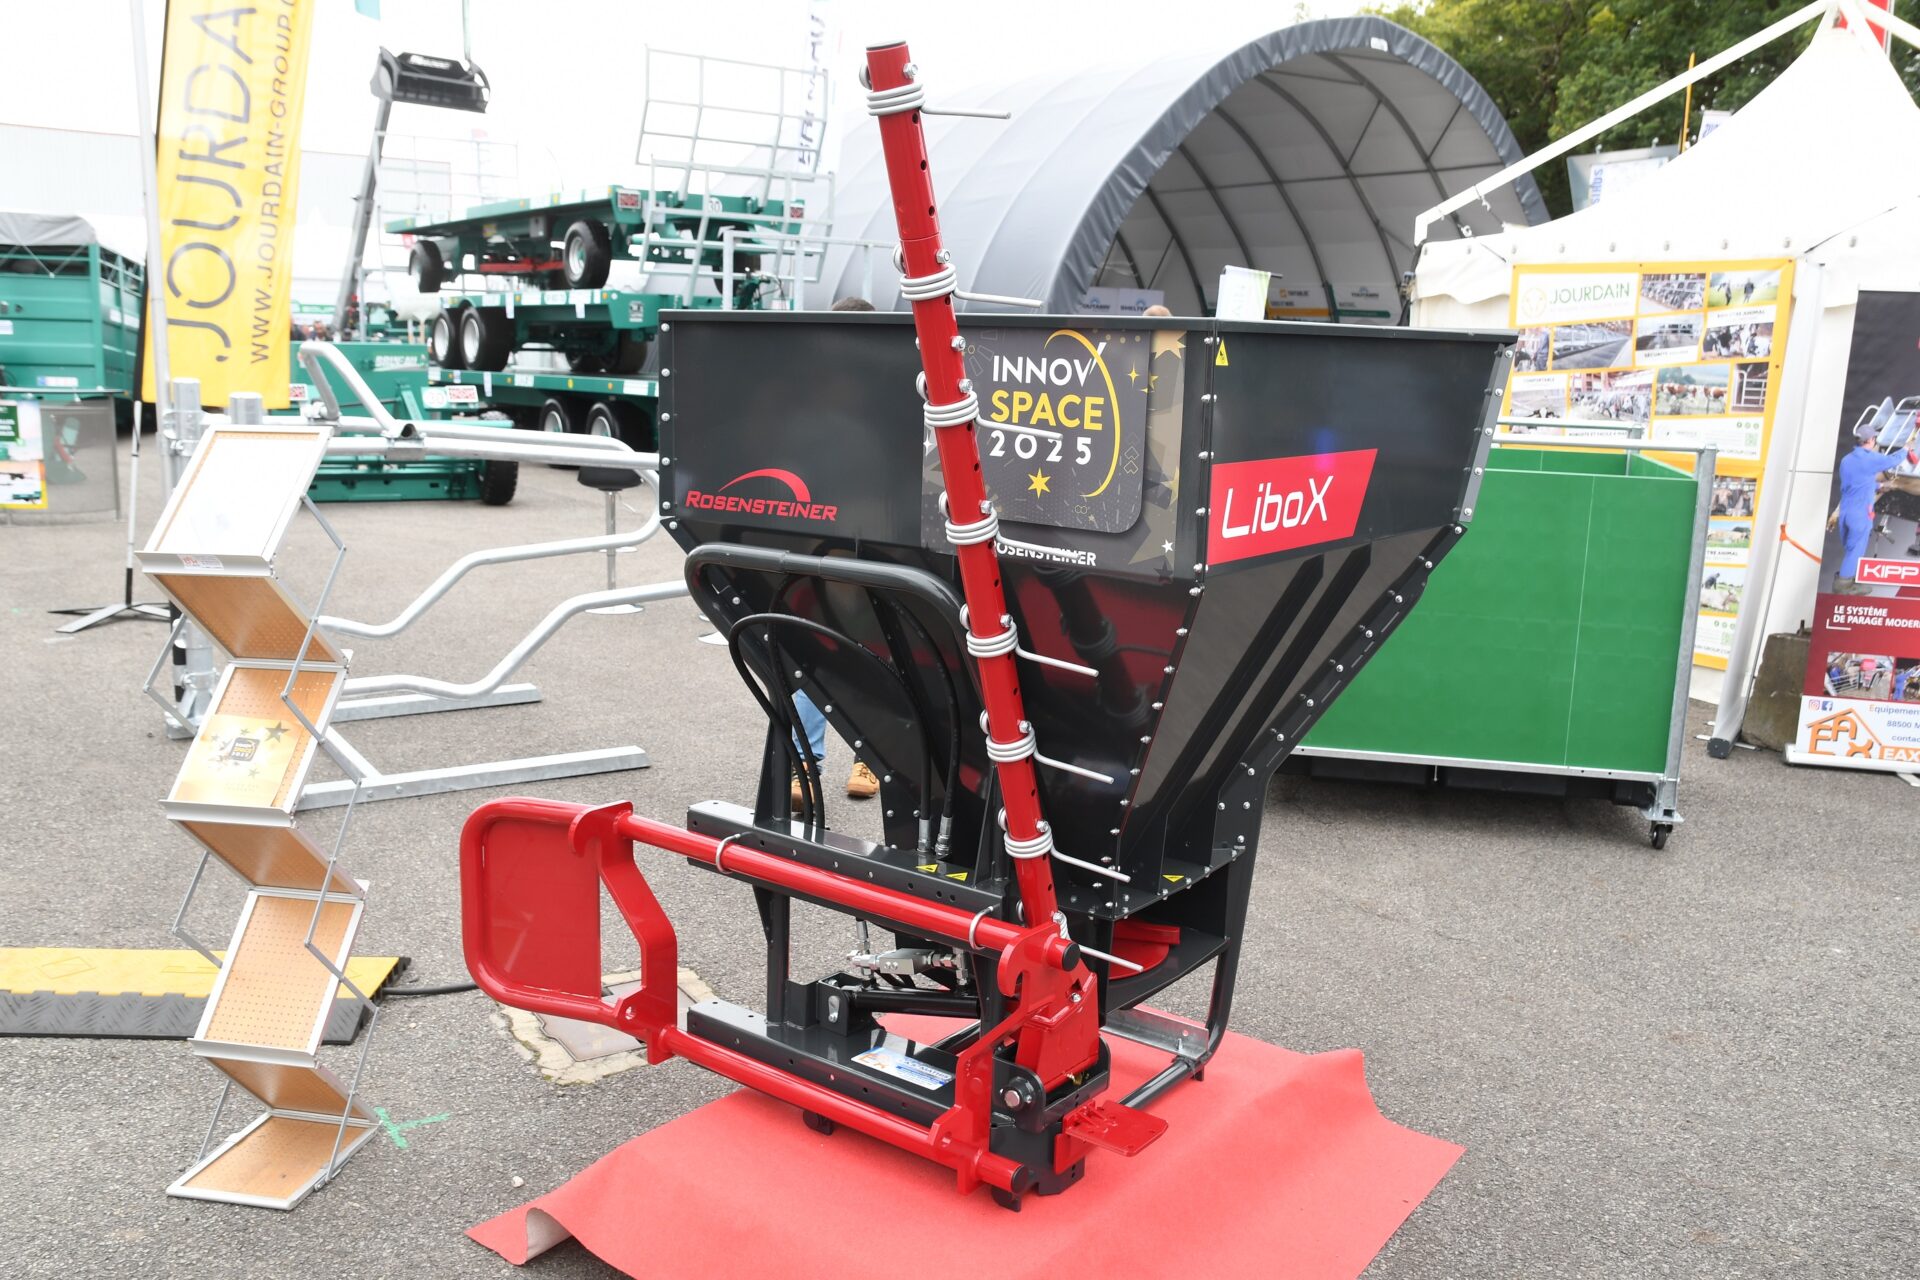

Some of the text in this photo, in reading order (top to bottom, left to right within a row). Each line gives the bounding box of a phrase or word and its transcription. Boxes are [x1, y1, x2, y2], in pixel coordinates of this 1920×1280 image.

[1550, 282, 1631, 304] JOURDAIN
[990, 389, 1105, 431] SPACE
[989, 429, 1092, 465] 2025
[685, 490, 838, 521] ROSENSTEINER
[1222, 475, 1334, 539] LiboX
[1863, 563, 1920, 580] KIPP
[1833, 604, 1888, 617] LE SYSTÈME
[1833, 614, 1920, 629] DE PARAGE MODER
